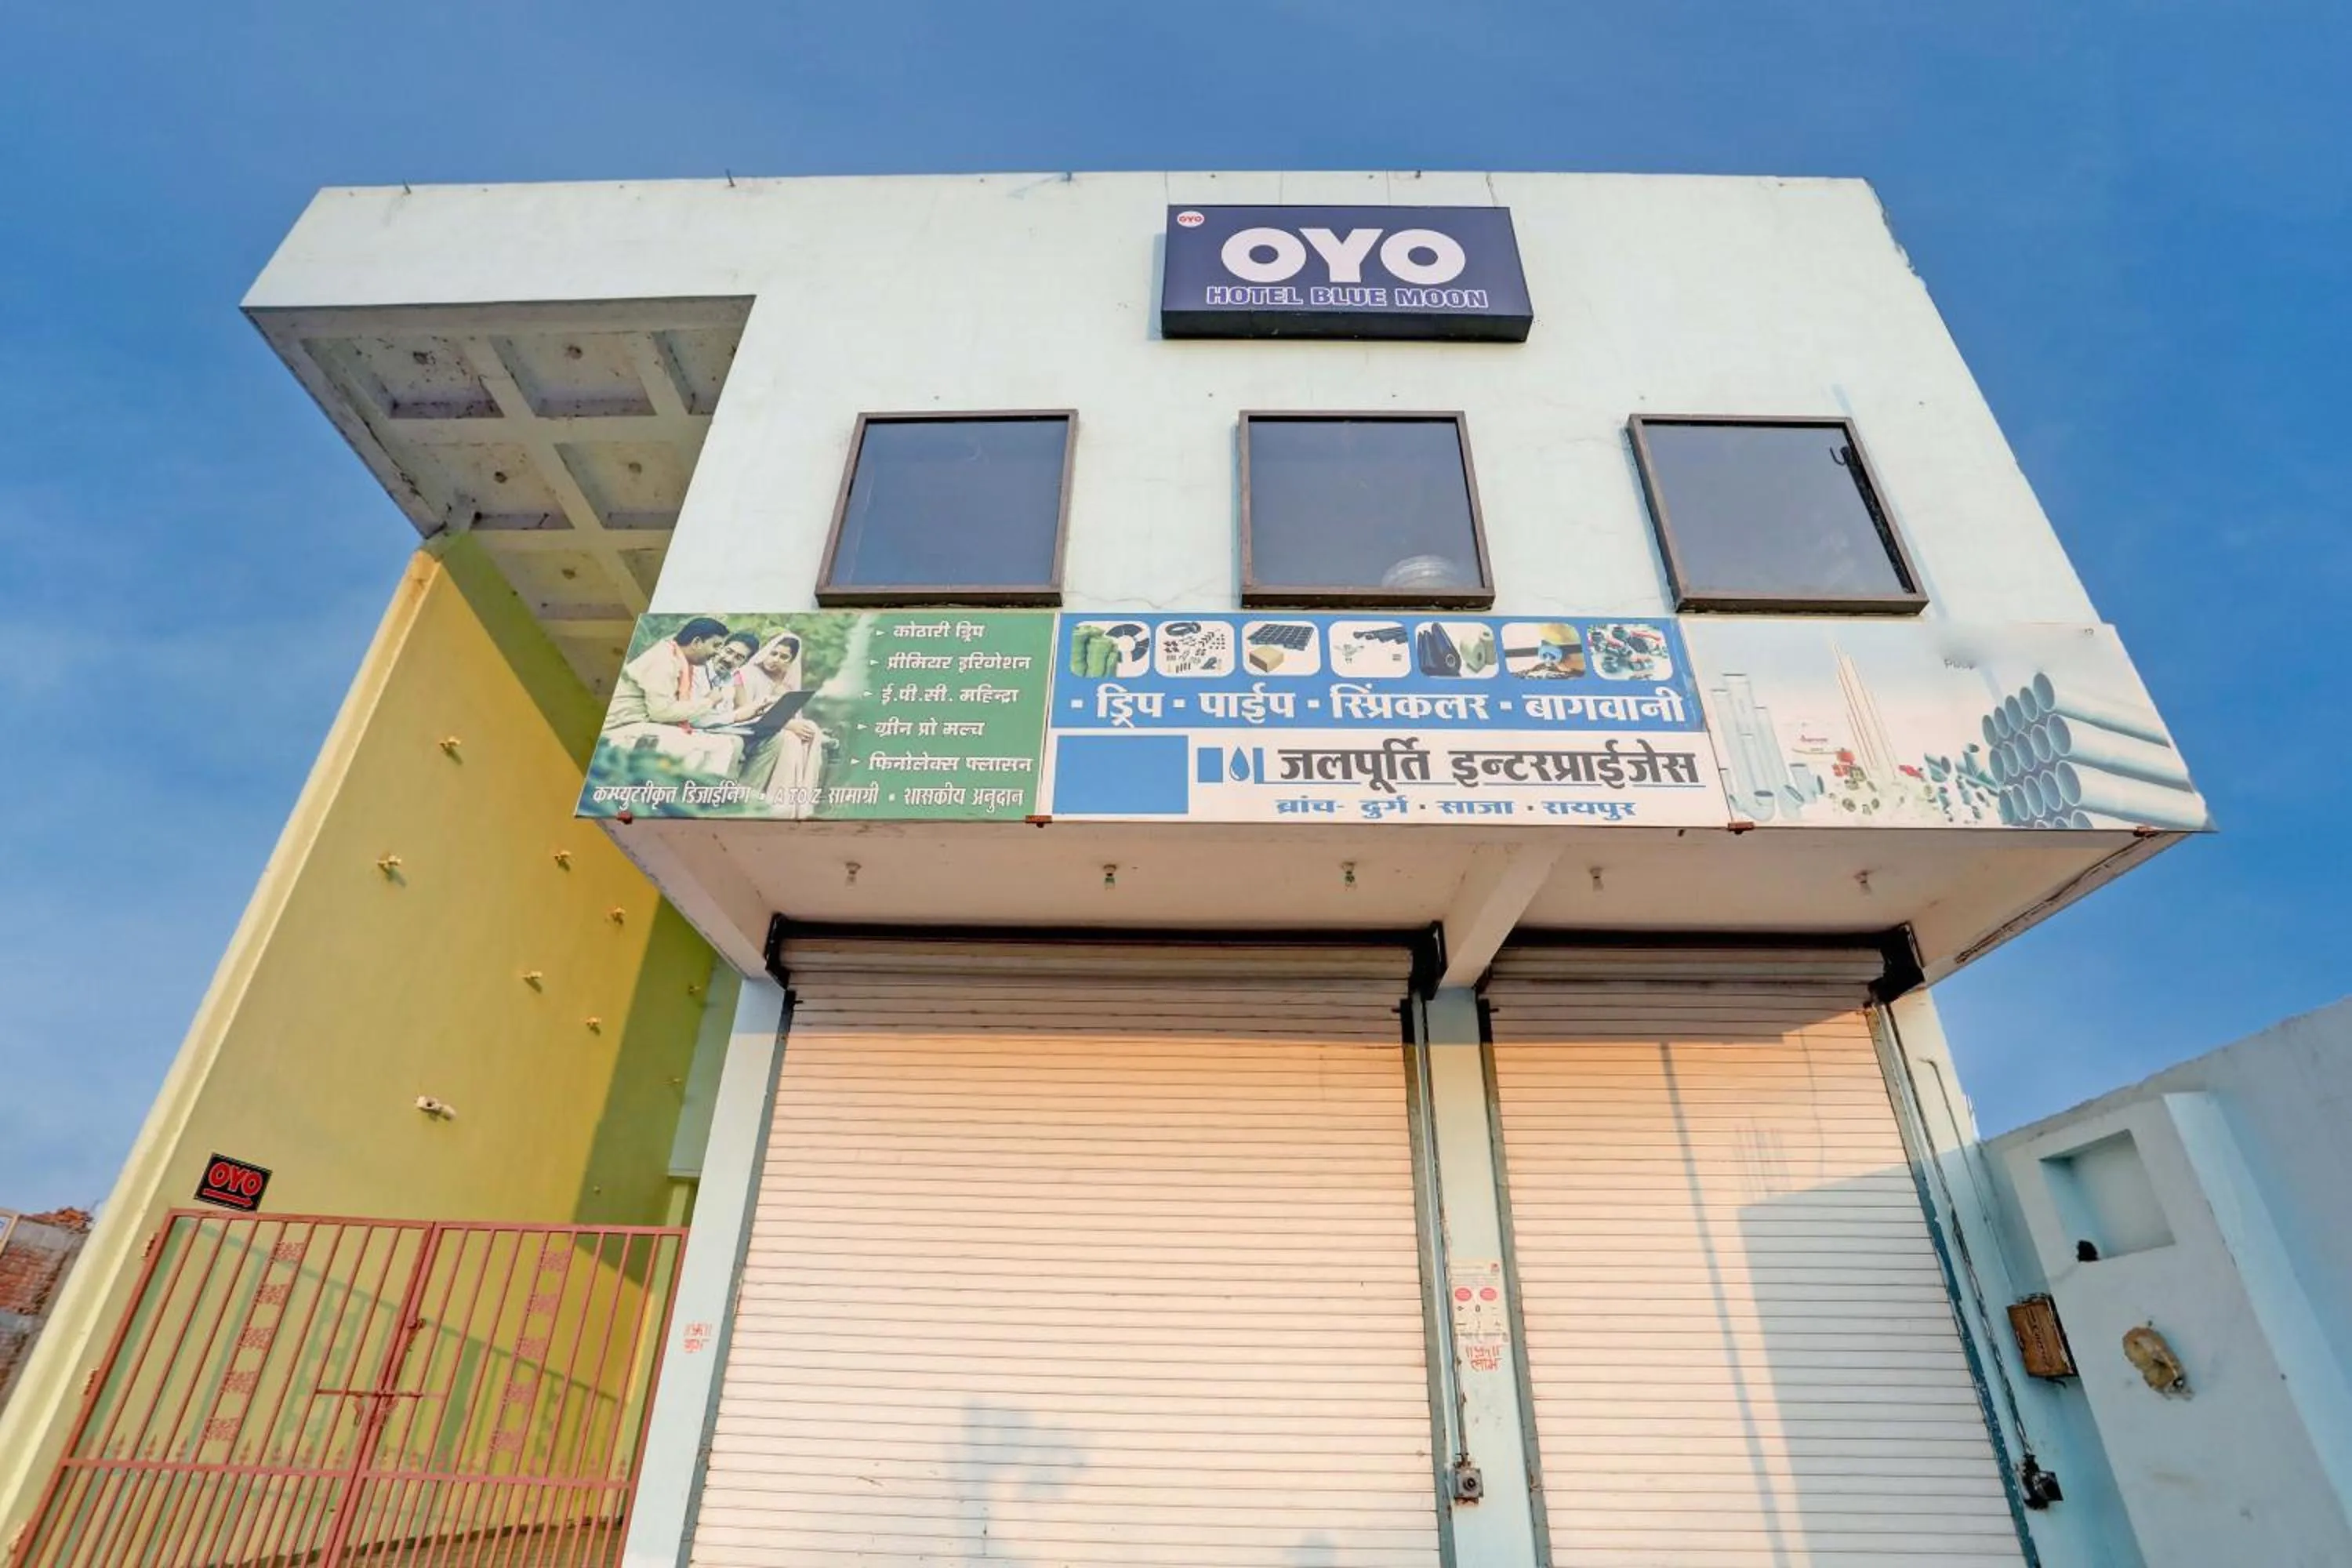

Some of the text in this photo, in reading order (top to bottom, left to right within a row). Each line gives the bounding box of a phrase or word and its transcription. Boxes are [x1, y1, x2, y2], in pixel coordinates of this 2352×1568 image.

[1221, 227, 1466, 285] OYO
[1206, 286, 1488, 308] HOTEL BLUE MOON
[893, 620, 985, 642] कोठारी ड्रिप
[887, 652, 954, 670] प्रीमियर
[1096, 682, 1686, 728] ड्रिप पाईप स्प्रिंकलर बागवानी
[875, 716, 913, 738] ग्रीन
[918, 717, 938, 737] प्रो
[1278, 736, 1700, 793] जलपूर्ति इन्टरप्राईजेस
[905, 782, 966, 805] शासकीय
[972, 788, 1024, 813] अनुदान
[1436, 800, 1515, 815] साजा
[1541, 800, 1637, 822] रायपुर
[209, 1161, 263, 1196] OYO
